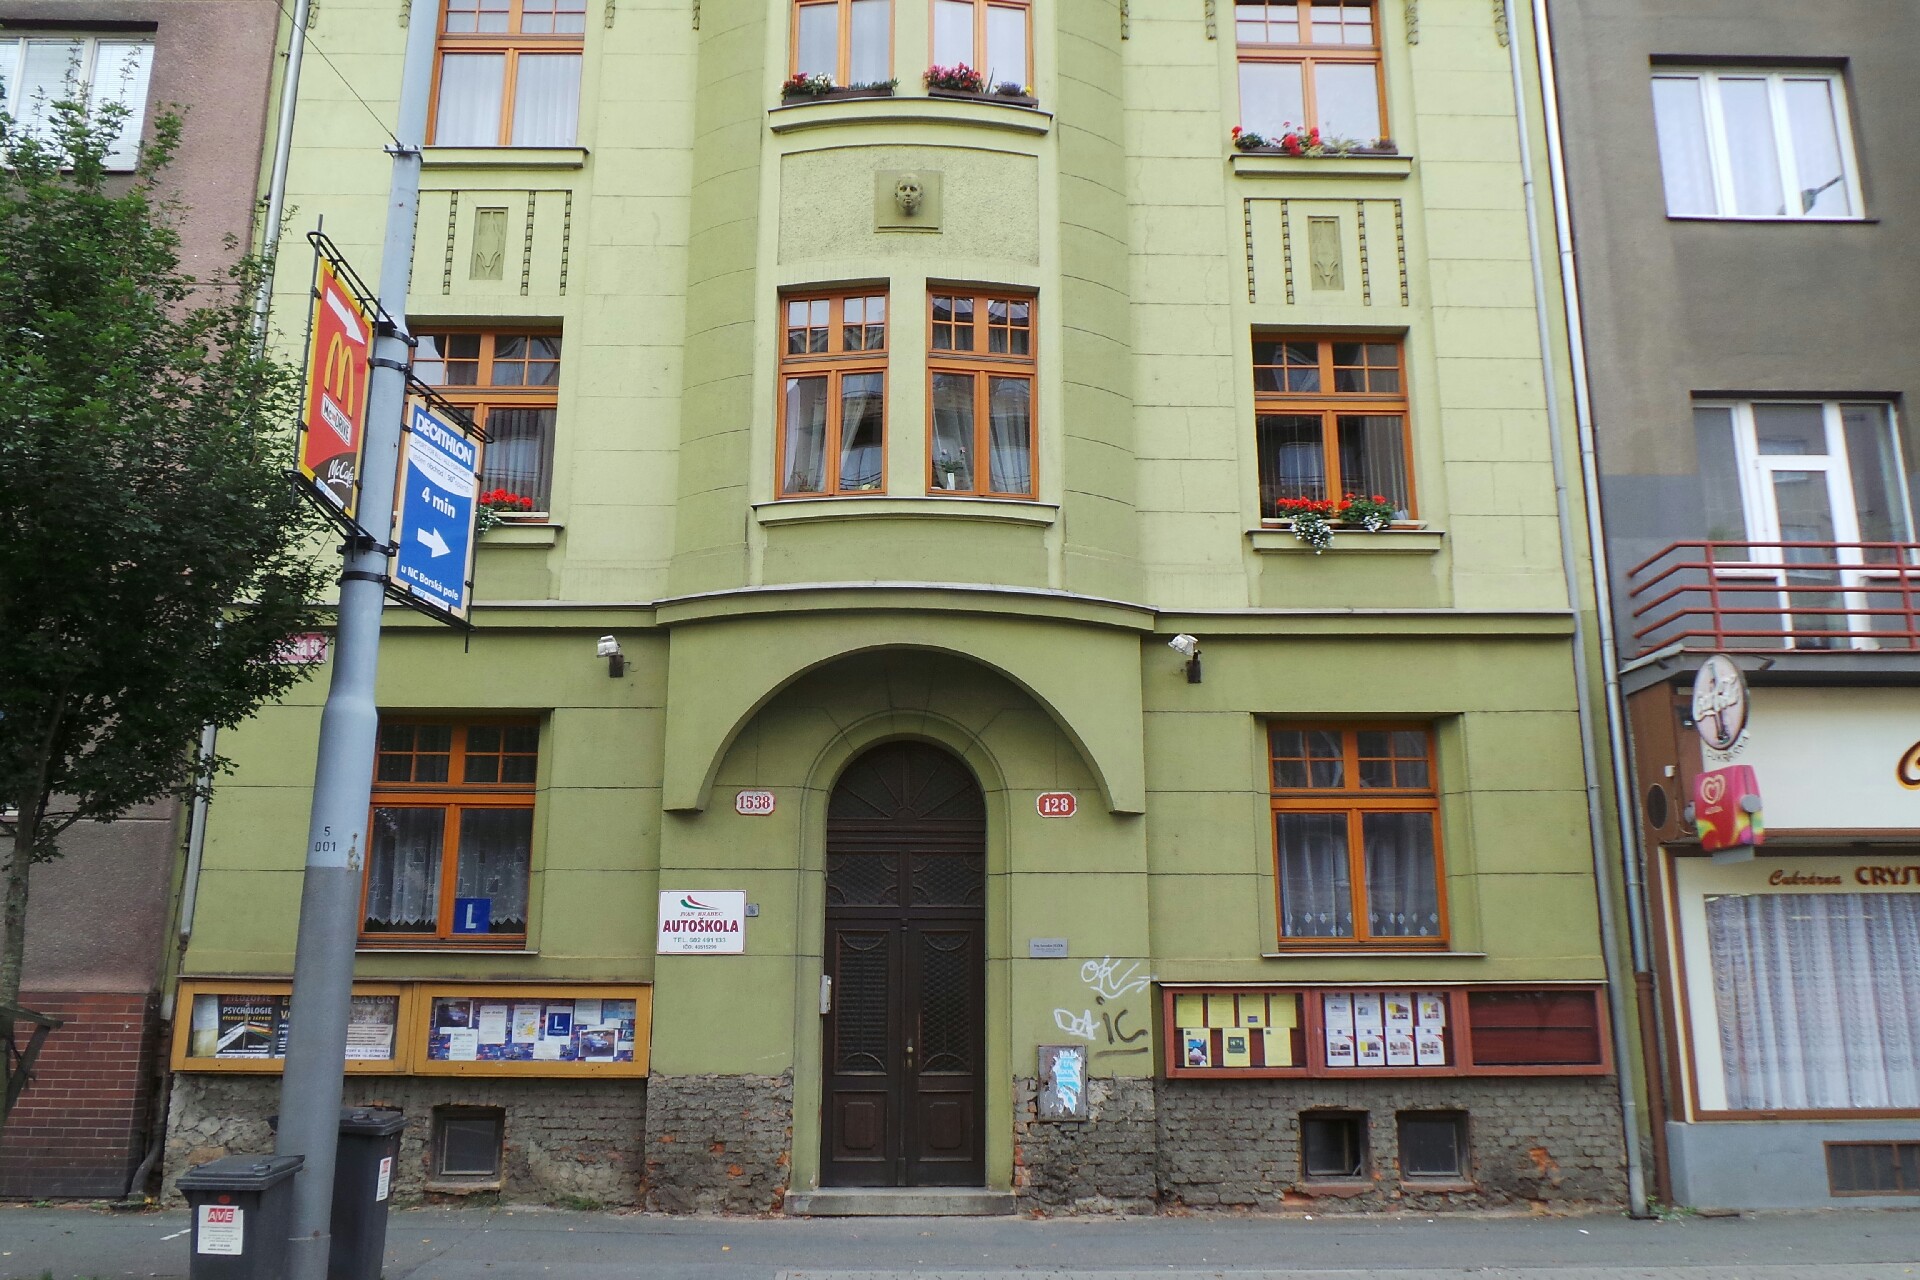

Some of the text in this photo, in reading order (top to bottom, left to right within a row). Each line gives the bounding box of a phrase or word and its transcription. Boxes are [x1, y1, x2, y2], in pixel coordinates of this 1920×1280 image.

[415, 412, 473, 466] DECATHLON
[422, 486, 455, 519] 4 min
[401, 565, 406, 574] u
[408, 566, 418, 580] NC
[420, 573, 443, 593] Borská
[443, 586, 458, 600] pole
[739, 795, 771, 809] 1538
[1044, 797, 1069, 812] 128
[324, 826, 331, 837] 5
[315, 841, 336, 852] 001
[465, 903, 477, 929] L
[663, 917, 739, 933] AUTOŠKOLA
[222, 1006, 272, 1015] PSYCHOLOGIE
[554, 1015, 563, 1029] L
[208, 1211, 234, 1221] AVE
